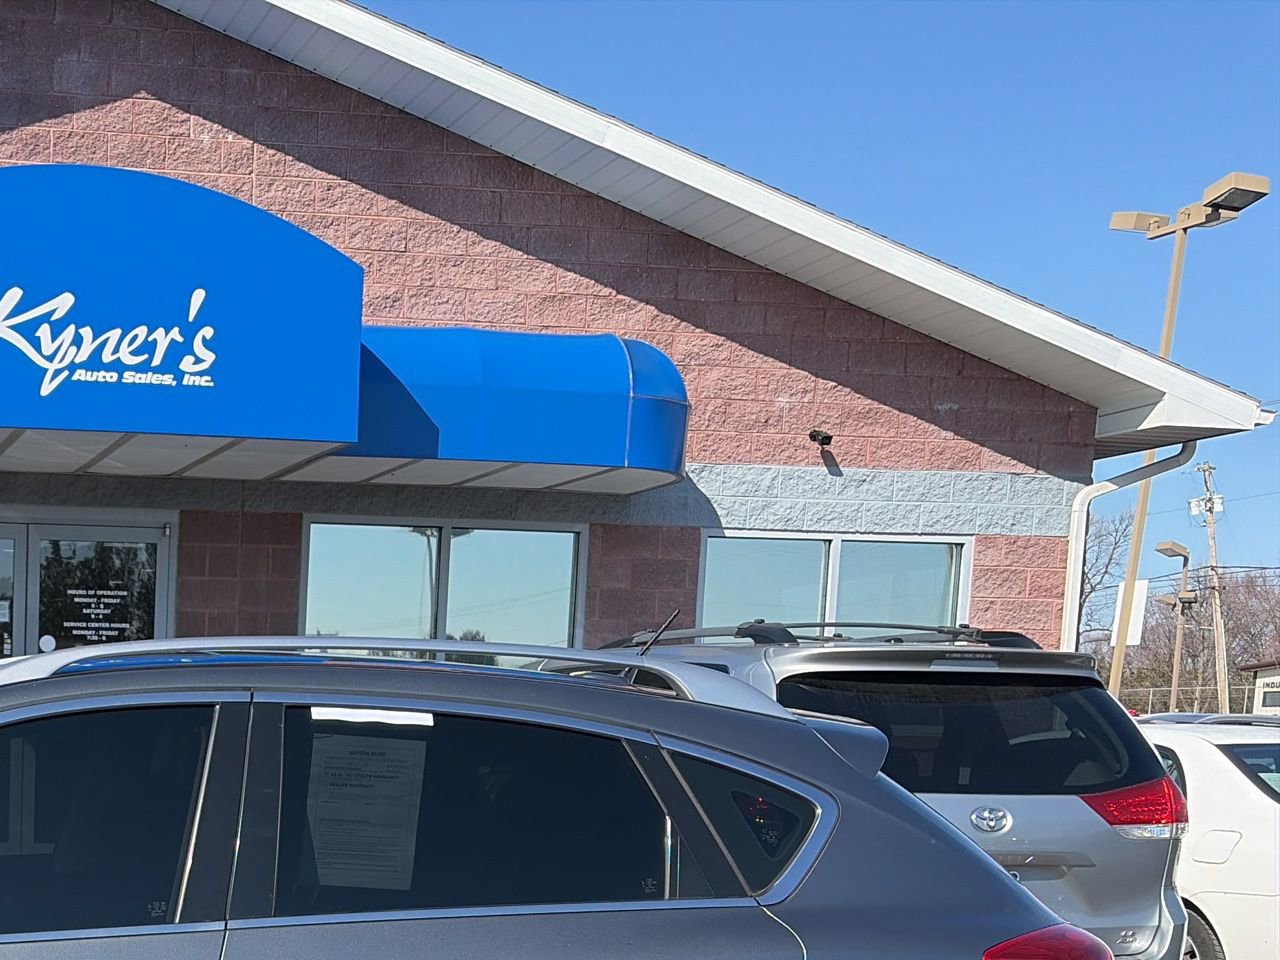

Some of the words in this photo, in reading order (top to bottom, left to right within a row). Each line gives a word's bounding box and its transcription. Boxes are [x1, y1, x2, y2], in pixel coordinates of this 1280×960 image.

[71, 368, 118, 383] Auto
[121, 371, 177, 387] Sales,
[182, 373, 215, 387] Inc.
